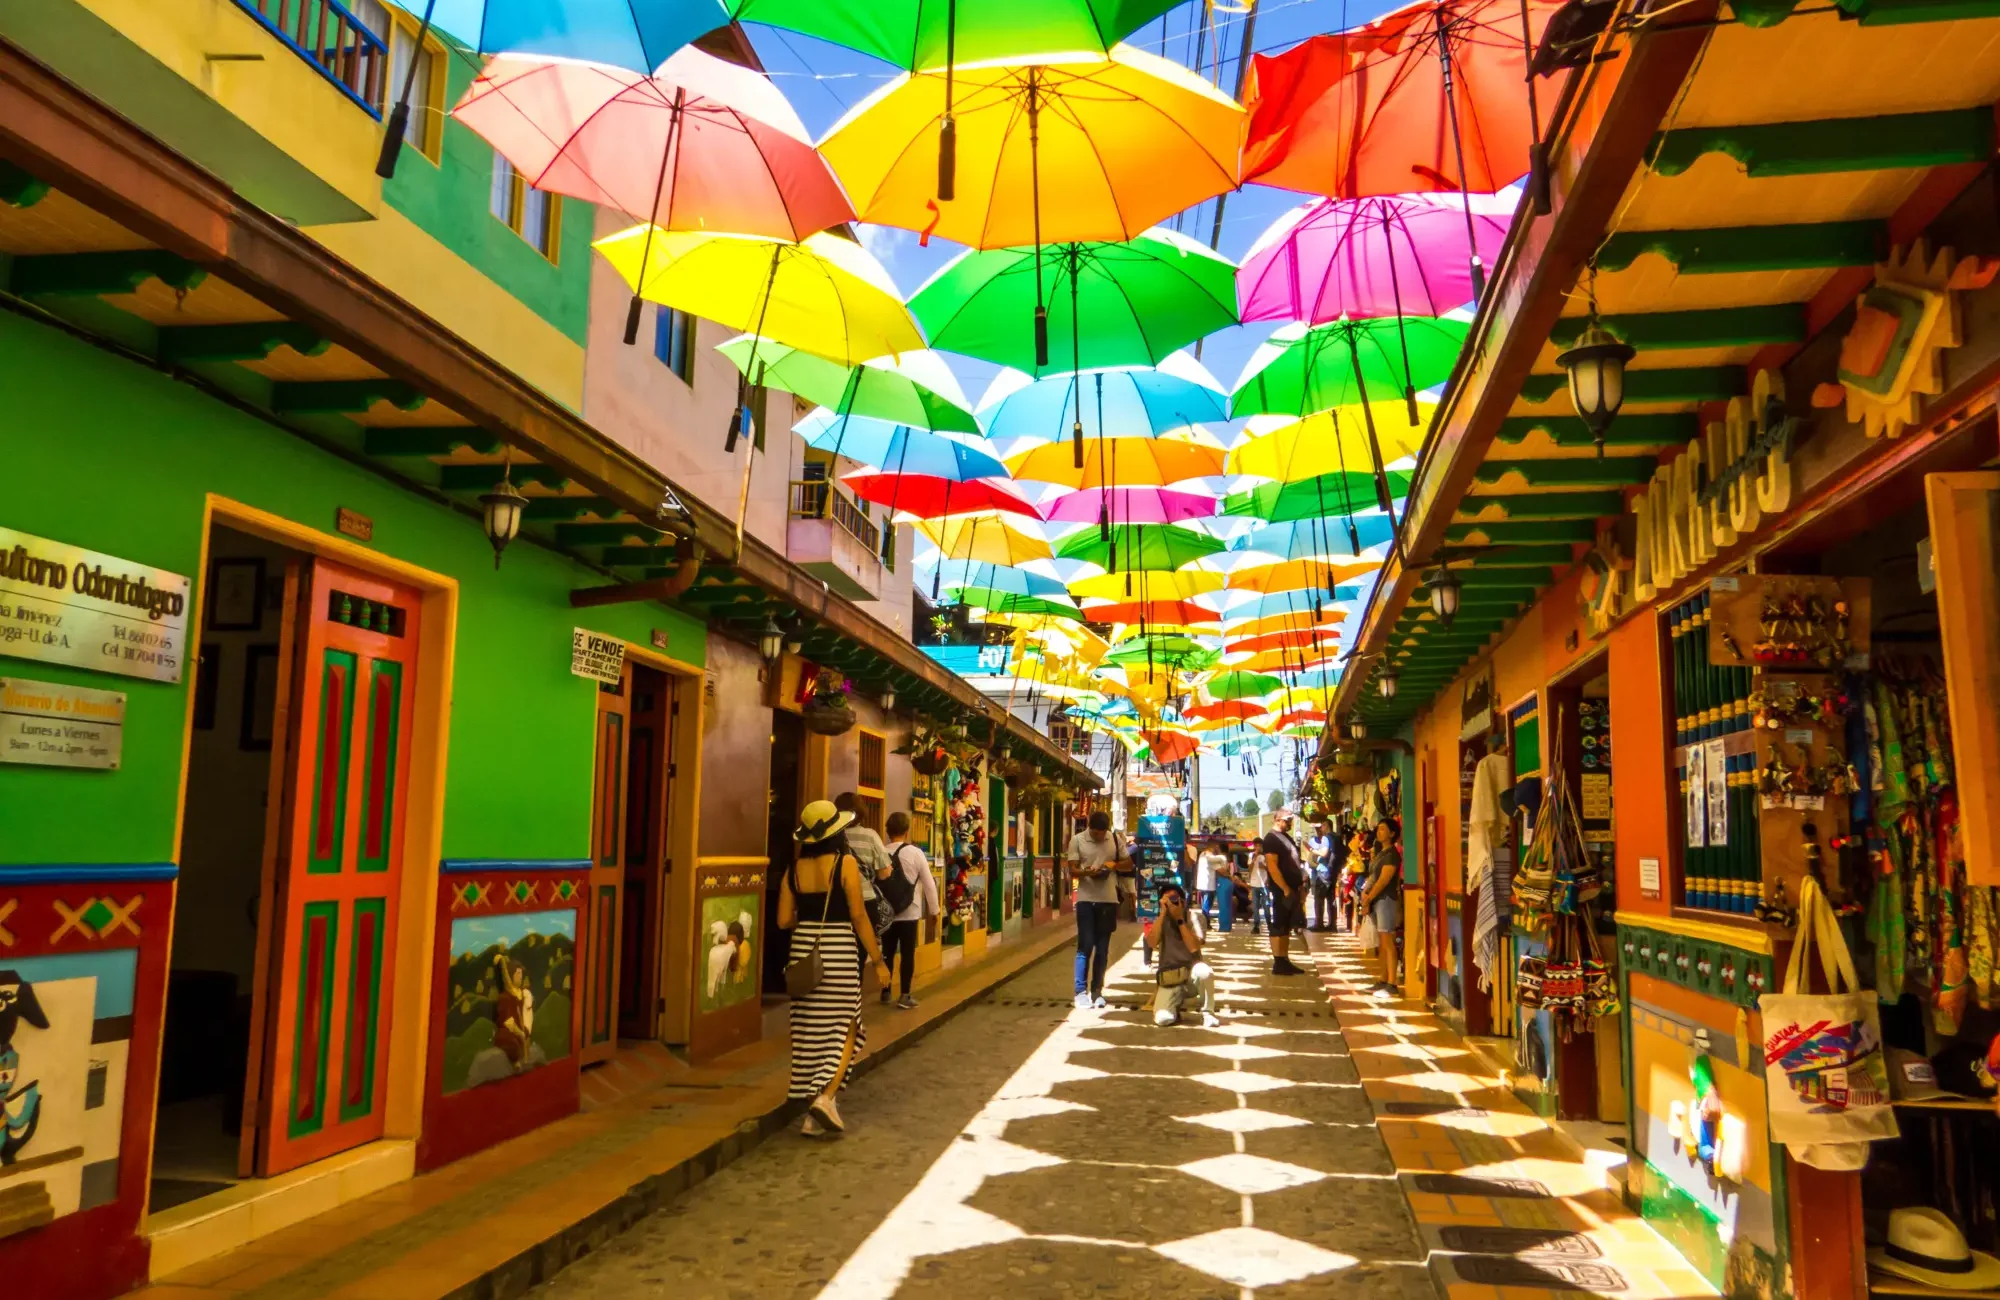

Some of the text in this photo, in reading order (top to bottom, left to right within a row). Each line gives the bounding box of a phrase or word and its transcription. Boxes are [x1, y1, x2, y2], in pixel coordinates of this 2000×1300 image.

[0, 545, 67, 589] ultorio
[42, 630, 58, 645] de
[574, 632, 624, 658] SE VENDE
[21, 721, 101, 741] Lunes a Viernes
